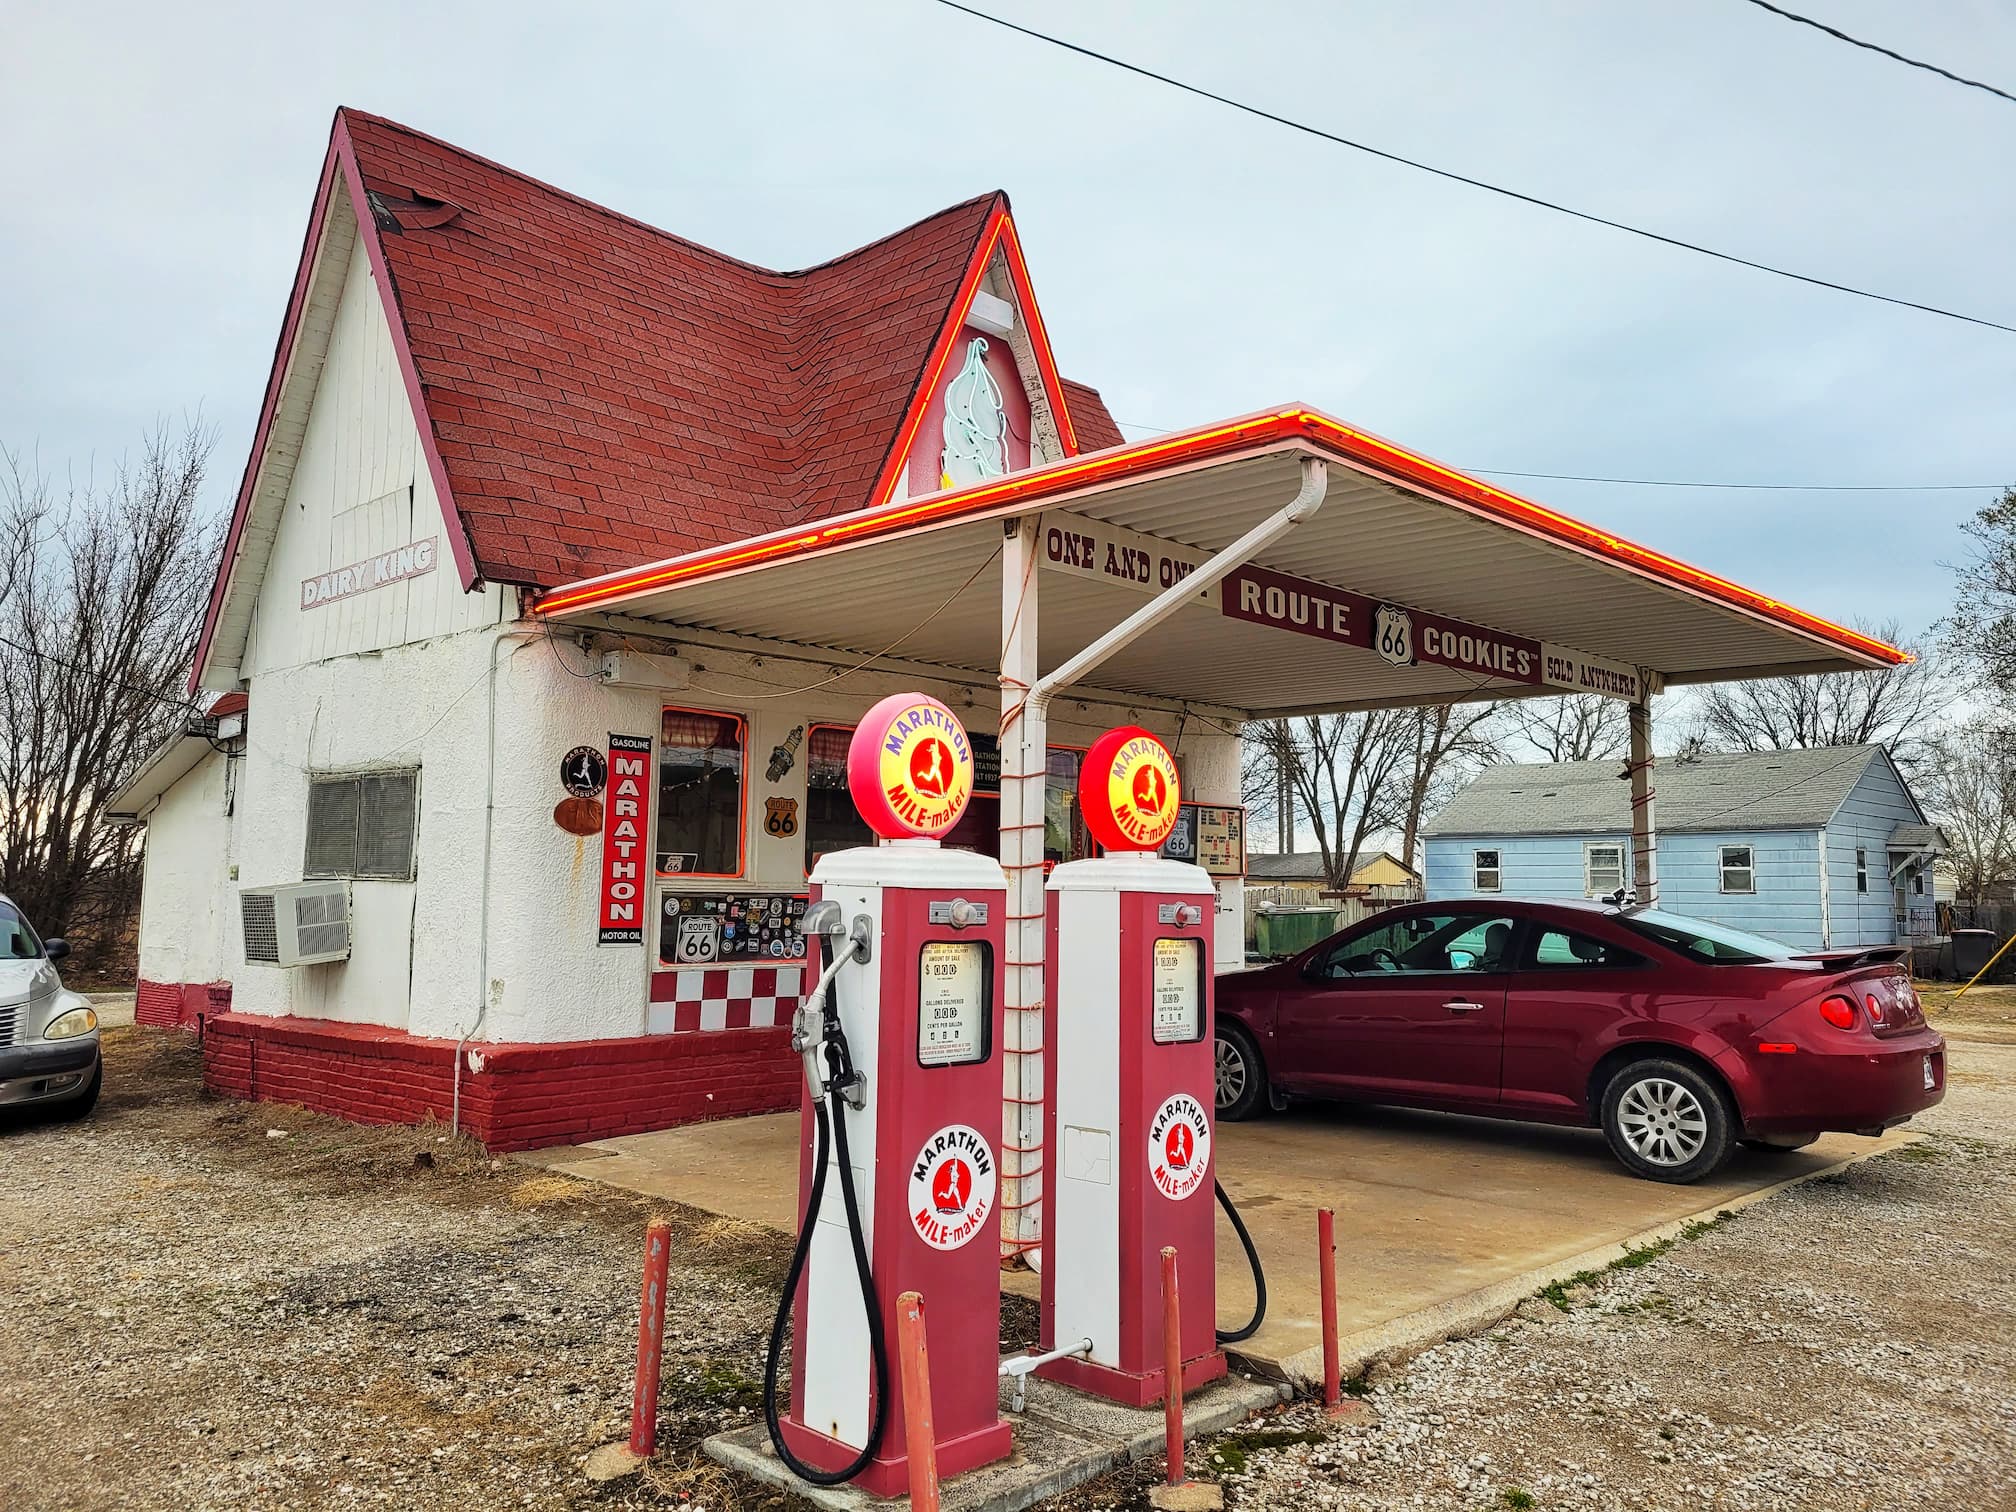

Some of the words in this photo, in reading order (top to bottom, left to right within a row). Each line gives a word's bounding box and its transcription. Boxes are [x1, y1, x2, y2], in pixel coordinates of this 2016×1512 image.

[303, 564, 367, 606] DAIRY
[374, 541, 432, 583] KING
[1047, 527, 1095, 570] ONE
[1104, 543, 1151, 584] AND
[1159, 557, 1207, 598] ON
[1240, 578, 1350, 636] ROUTE
[1388, 614, 1400, 623] US
[1381, 623, 1405, 657] 66
[1547, 657, 1574, 683] SOLD
[1580, 664, 1636, 697] ANYWHERE
[611, 738, 649, 750] GASOLINE
[886, 708, 969, 763] MARATHON
[564, 747, 605, 766] MARATHON
[1112, 739, 1177, 786] MARATHON
[565, 783, 603, 798] PRODUCTS
[769, 799, 794, 810] ROUTE
[887, 783, 966, 828] MILE-maker
[609, 757, 643, 920] MARATHON
[768, 811, 794, 834] 66
[1115, 803, 1175, 841] MILE-maker
[1171, 838, 1185, 851] 66
[668, 862, 679, 871] 66
[601, 931, 628, 940] MOTOR
[629, 931, 641, 940] OIL
[685, 934, 712, 957] 66
[687, 922, 713, 931] ROUTE
[1152, 1100, 1207, 1143] MARATHON
[913, 1131, 991, 1182] MARATHON
[1154, 1156, 1205, 1195] MILE-maker
[915, 1198, 987, 1245] MILE-maker
